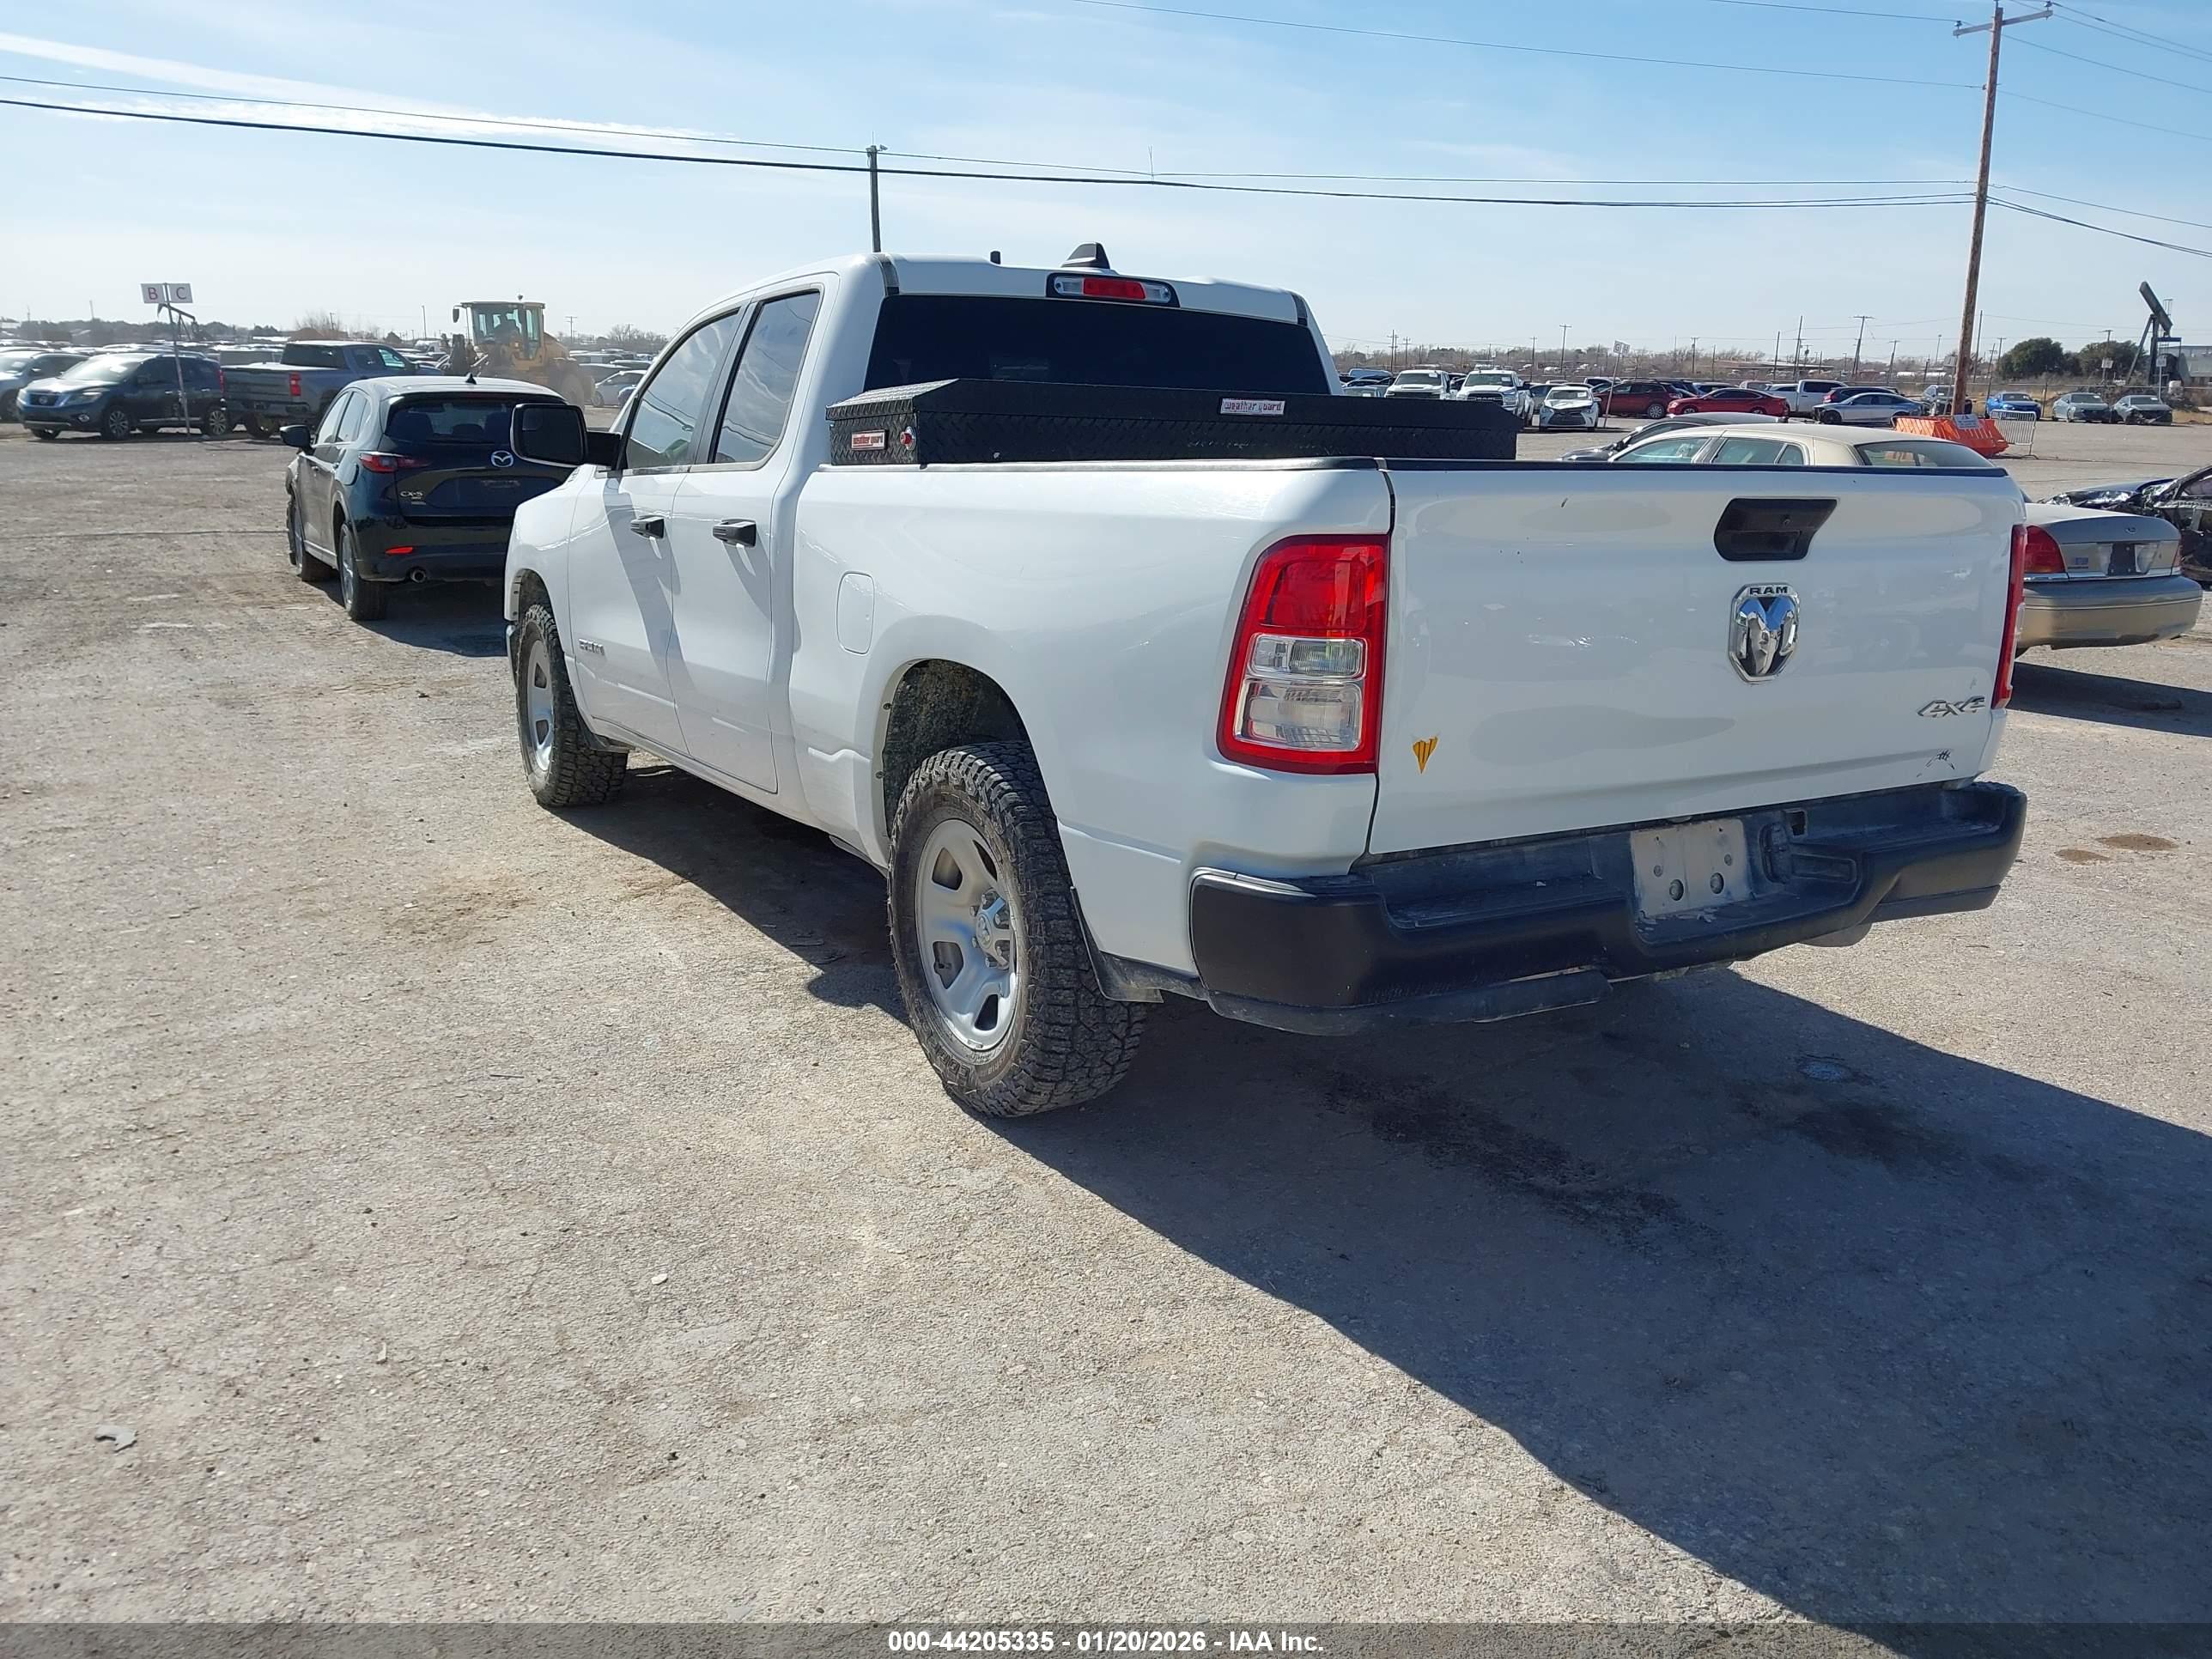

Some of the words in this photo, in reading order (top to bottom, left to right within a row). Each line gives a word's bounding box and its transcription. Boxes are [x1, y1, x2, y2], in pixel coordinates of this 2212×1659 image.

[147, 287, 159, 301] B
[176, 287, 187, 301] C
[1749, 586, 1788, 595] RAM
